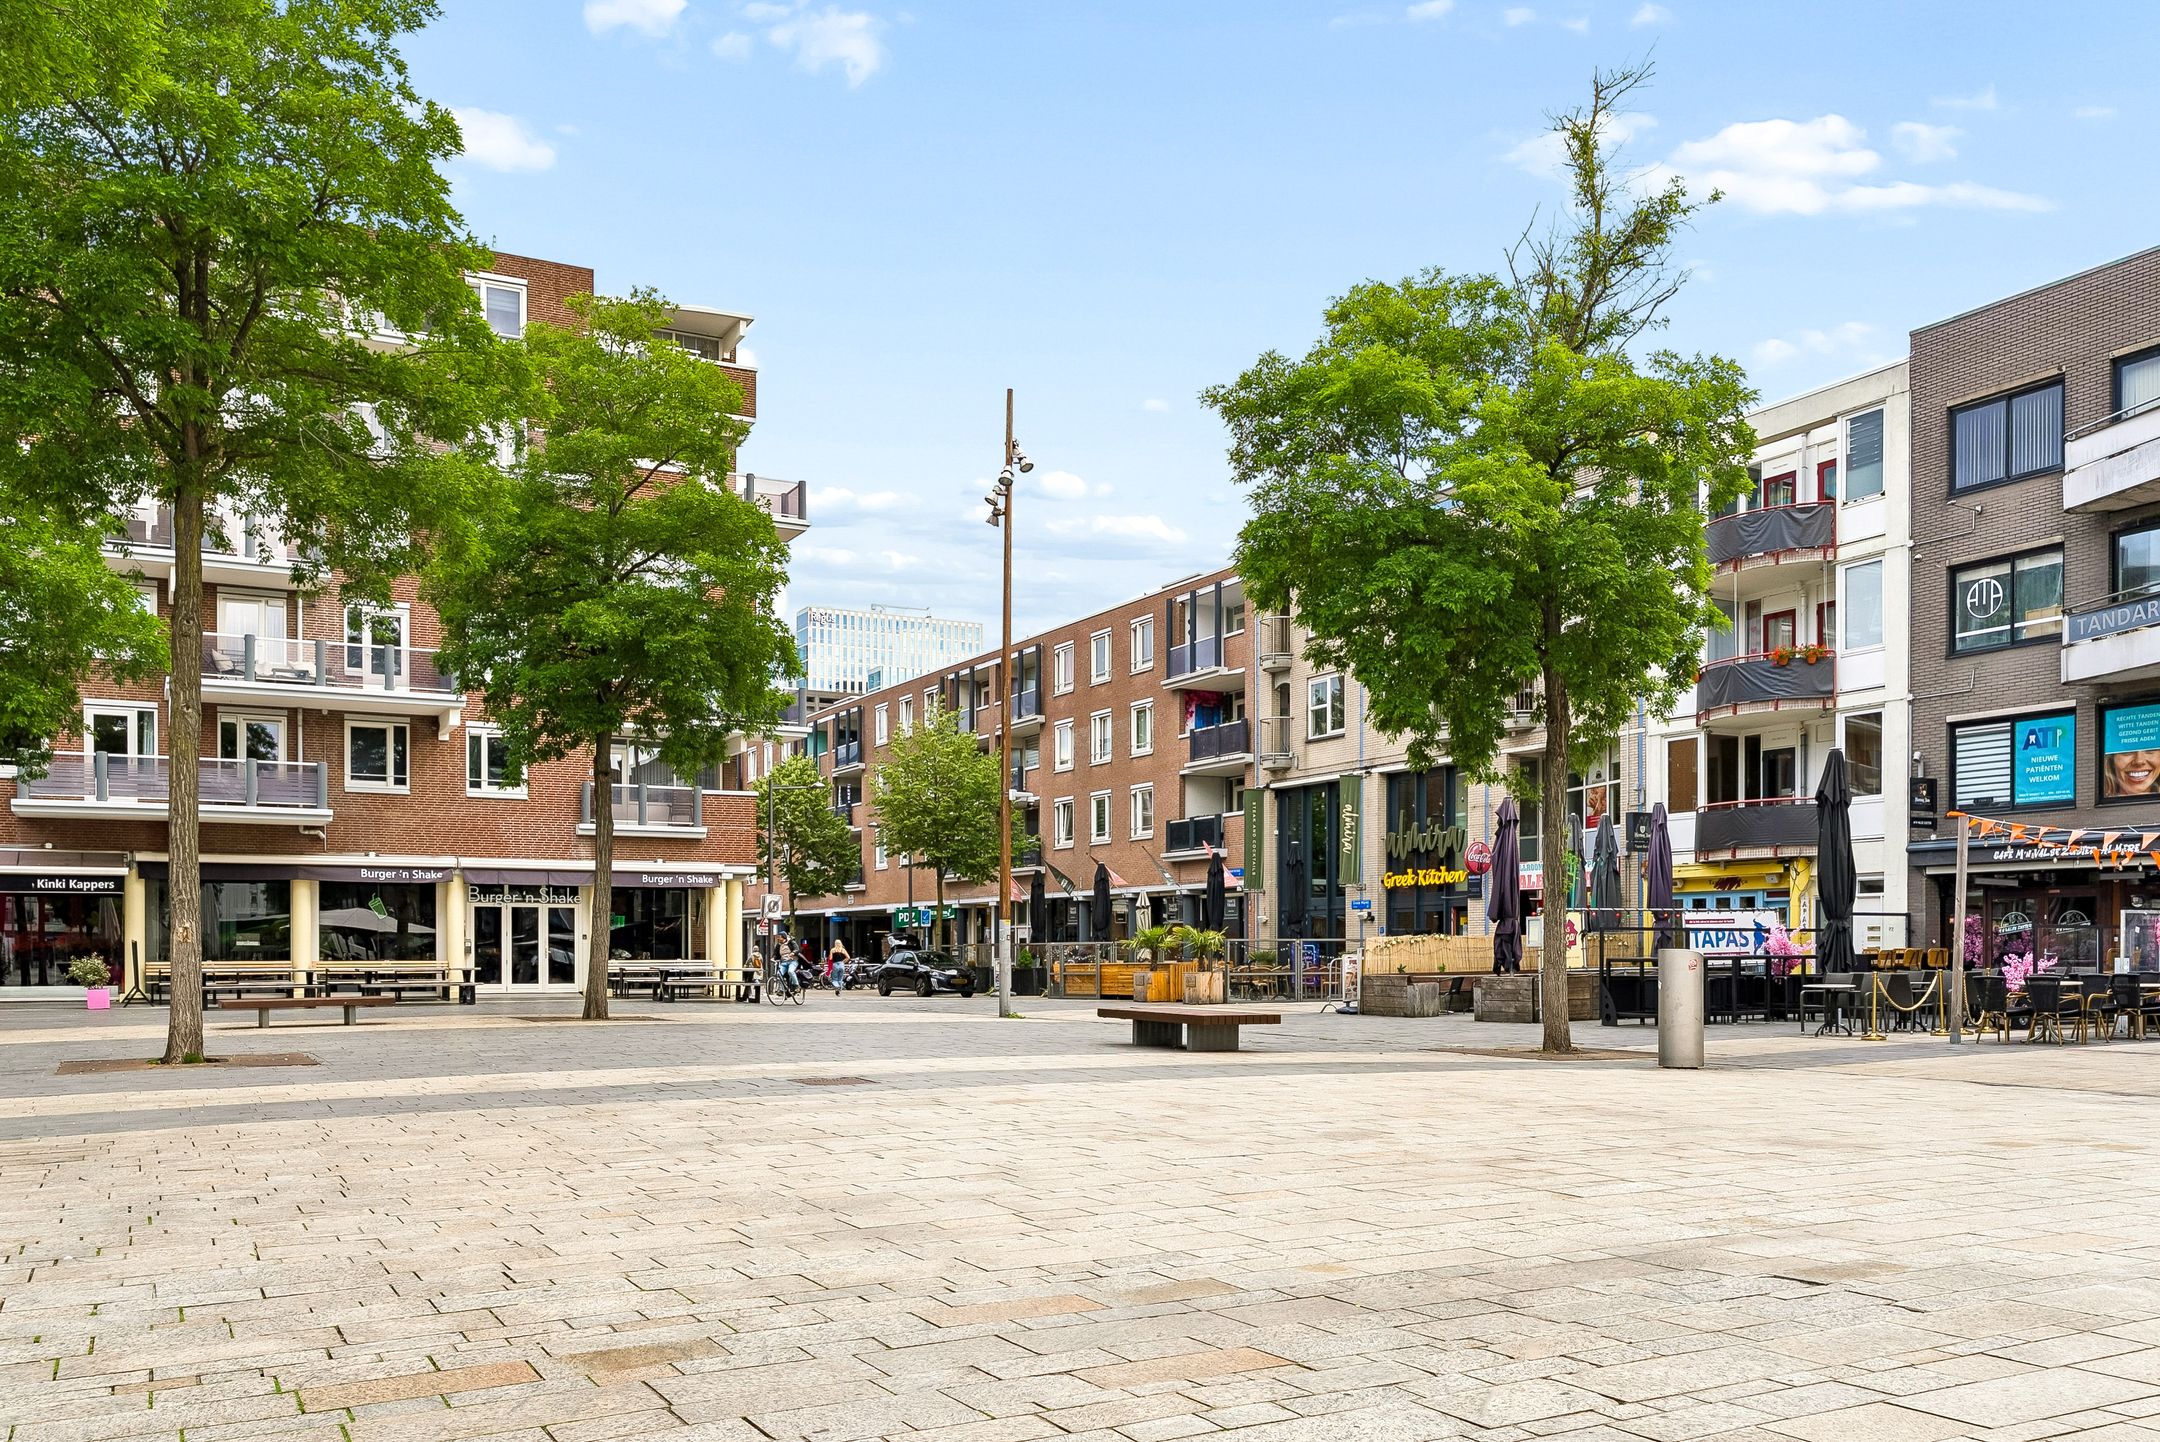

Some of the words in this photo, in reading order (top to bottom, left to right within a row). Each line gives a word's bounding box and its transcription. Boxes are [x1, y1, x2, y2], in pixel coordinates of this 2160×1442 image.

[2077, 599, 2160, 635] TANDAR
[2136, 719, 2159, 728] TANDEN
[2118, 729, 2142, 737] GEZOND
[2031, 754, 2059, 763] NIEUWE
[2029, 774, 2060, 783] WELKOM
[360, 868, 396, 881] Burger
[412, 869, 443, 880] Shake
[642, 874, 673, 886] Burger
[686, 874, 714, 884] Shake
[1383, 868, 1418, 889] Greek
[1417, 865, 1468, 886] Kitchen
[36, 878, 66, 889] Kinki
[69, 879, 115, 891] Kappers
[468, 886, 518, 906] Burger
[539, 887, 582, 904] Shake
[1690, 929, 1749, 948] TAPAS
